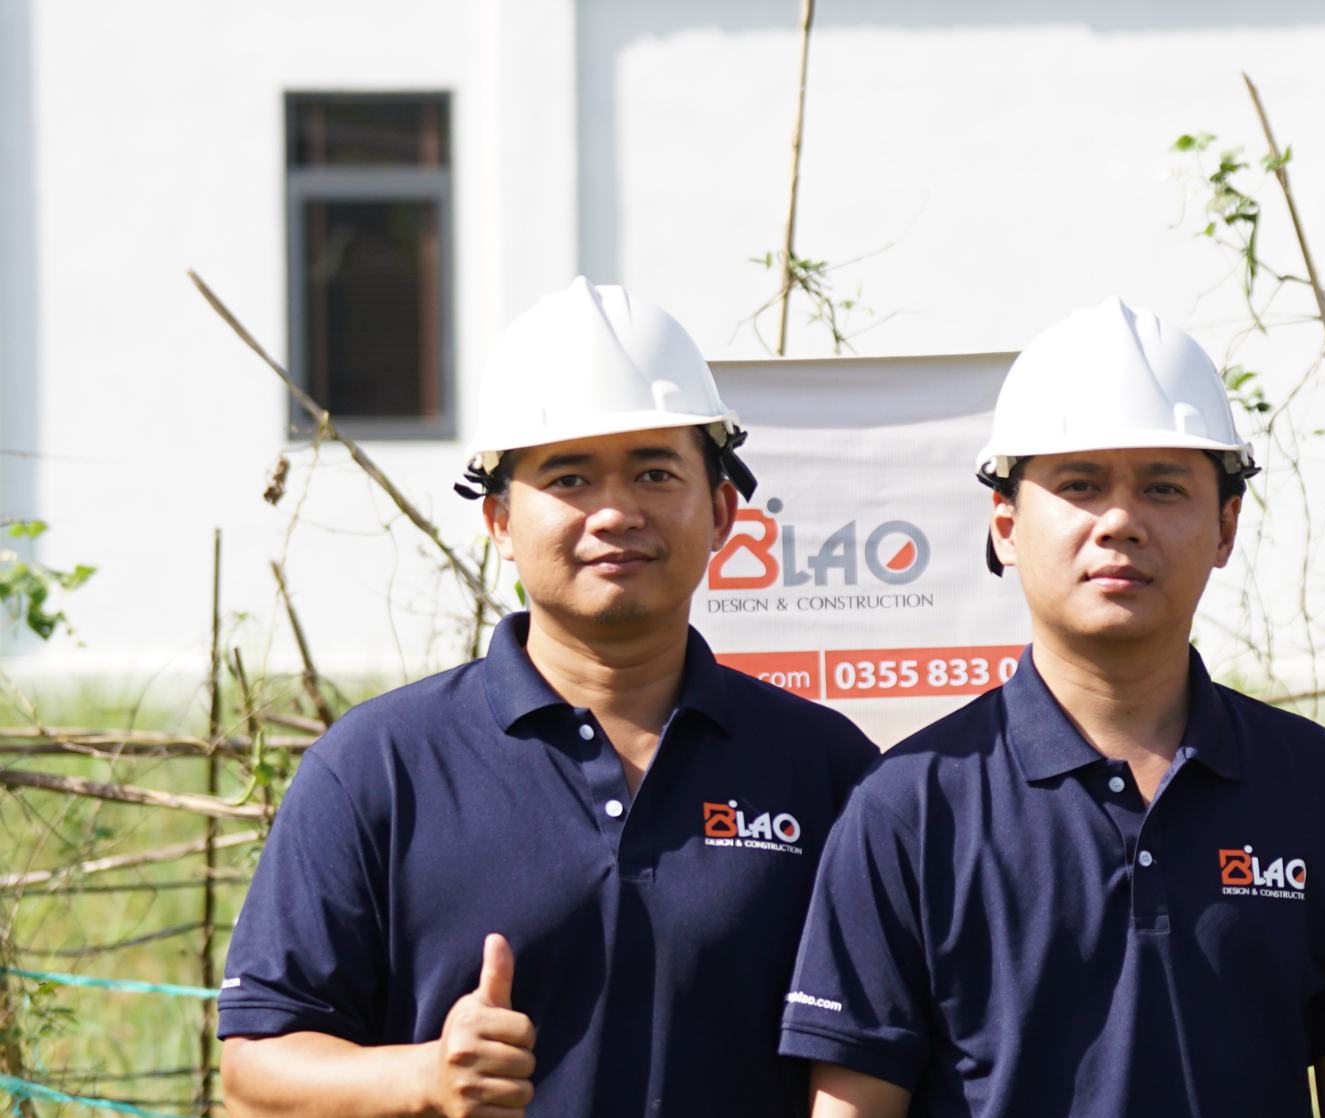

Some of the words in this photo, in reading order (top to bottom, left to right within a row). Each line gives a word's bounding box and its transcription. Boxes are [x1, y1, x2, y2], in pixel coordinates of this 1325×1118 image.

[708, 598, 769, 614] DESIGN
[776, 598, 789, 611] &
[797, 593, 934, 611] CONSTRUCTION
[834, 660, 919, 690] 0355
[927, 657, 990, 688] 833
[704, 837, 734, 847] DESIGN
[735, 839, 743, 847] &
[744, 840, 803, 855] CONSTRUCTION
[1222, 887, 1250, 896] DESIGN
[1251, 888, 1258, 896] &
